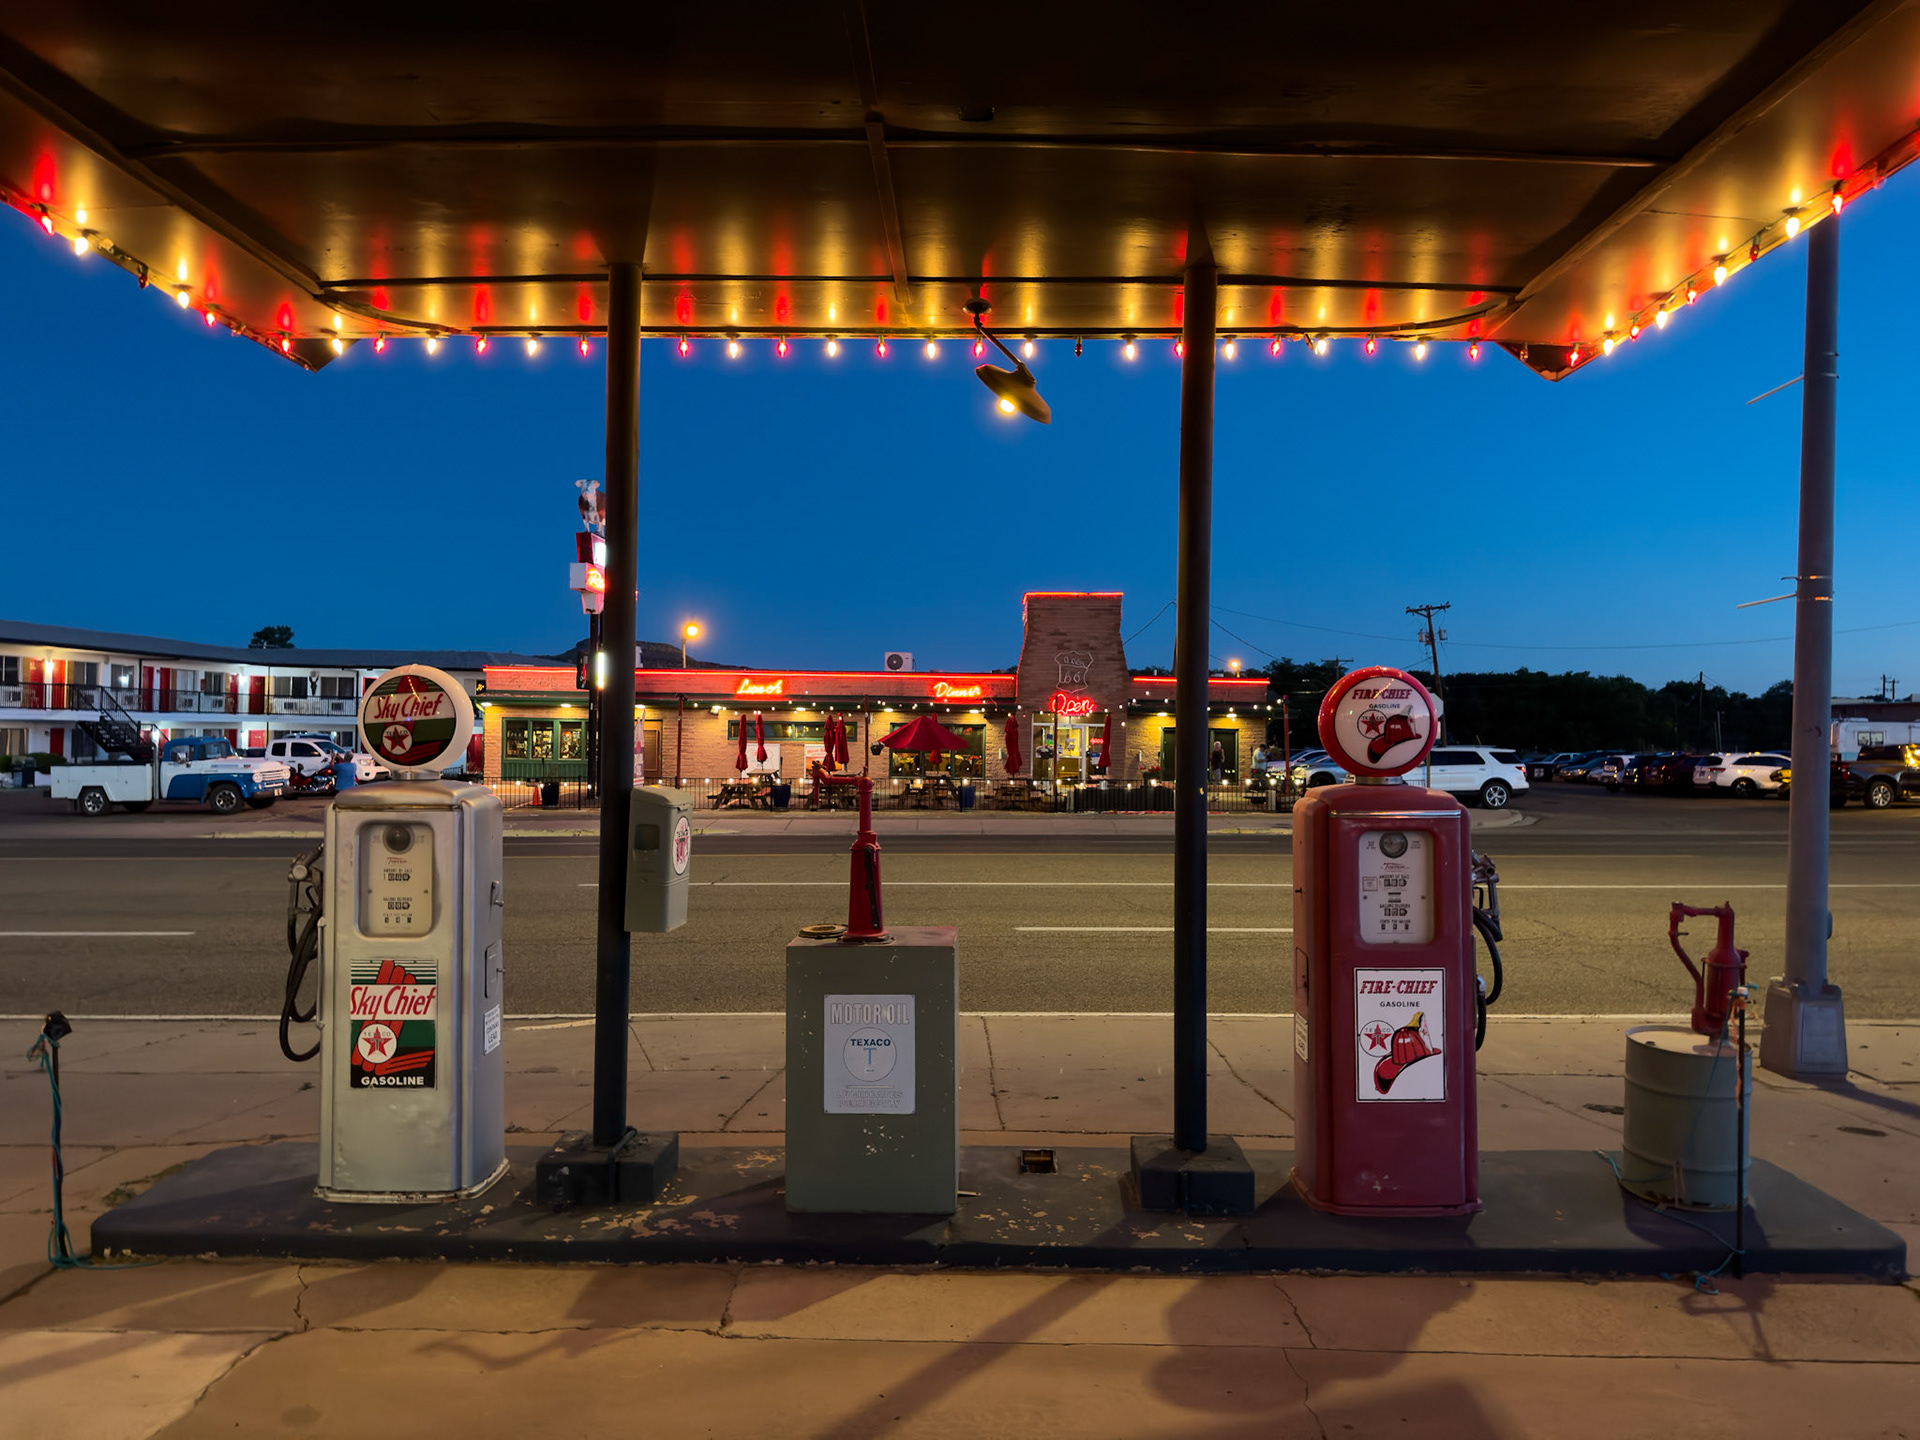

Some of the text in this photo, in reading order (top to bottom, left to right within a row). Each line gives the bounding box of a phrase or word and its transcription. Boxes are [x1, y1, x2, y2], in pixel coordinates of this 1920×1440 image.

[738, 678, 783, 695] Lunch
[933, 682, 981, 698] Dinner
[374, 692, 444, 721] Sky Chief
[1051, 693, 1095, 715] Open
[1359, 979, 1438, 994] FIRE-CHIEF
[350, 985, 437, 1020] Sky Chief
[830, 1003, 909, 1025] MOTOR OIL
[850, 1038, 892, 1047] TEXACO
[863, 1047, 877, 1065] T
[361, 1076, 425, 1086] GASOLINE
